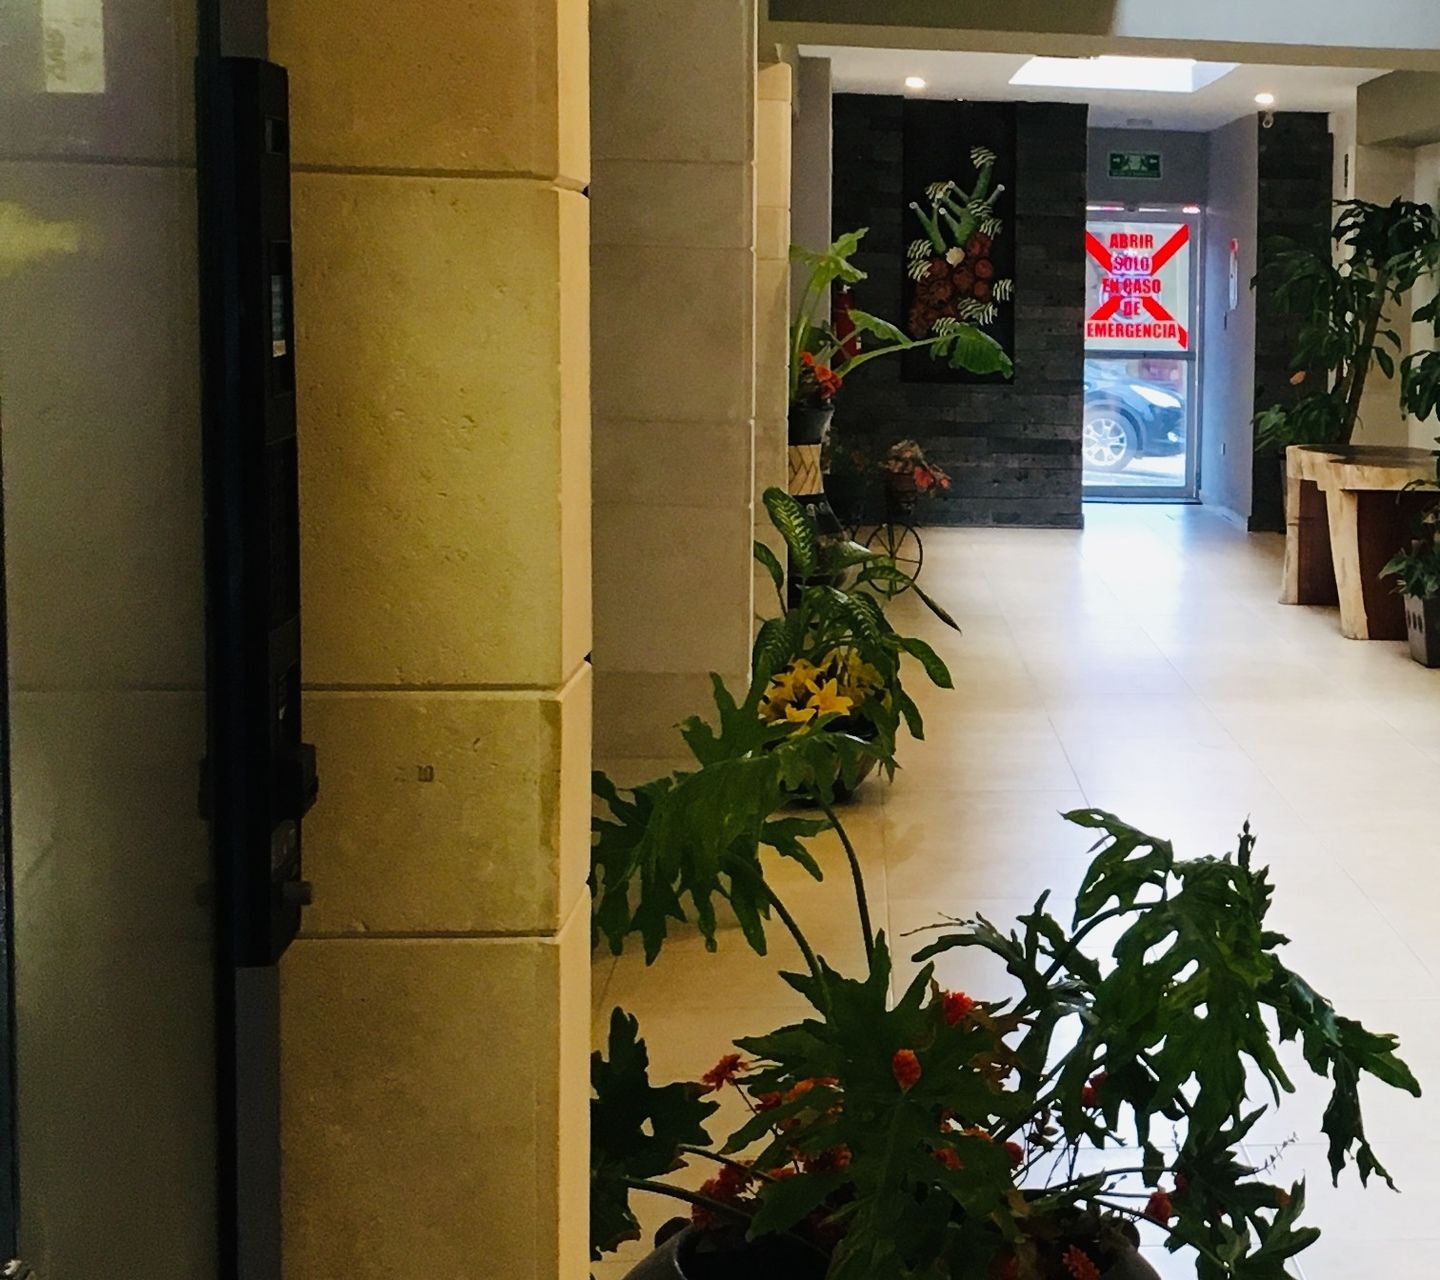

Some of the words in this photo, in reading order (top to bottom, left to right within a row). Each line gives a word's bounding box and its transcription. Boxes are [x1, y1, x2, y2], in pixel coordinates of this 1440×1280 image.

[1110, 234, 1153, 249] ABRIR
[1113, 256, 1150, 271] SOLO
[1103, 278, 1121, 294] EN
[1123, 279, 1161, 294] CASO
[1123, 301, 1141, 316] DE
[1087, 323, 1176, 338] EMERGENCIA
